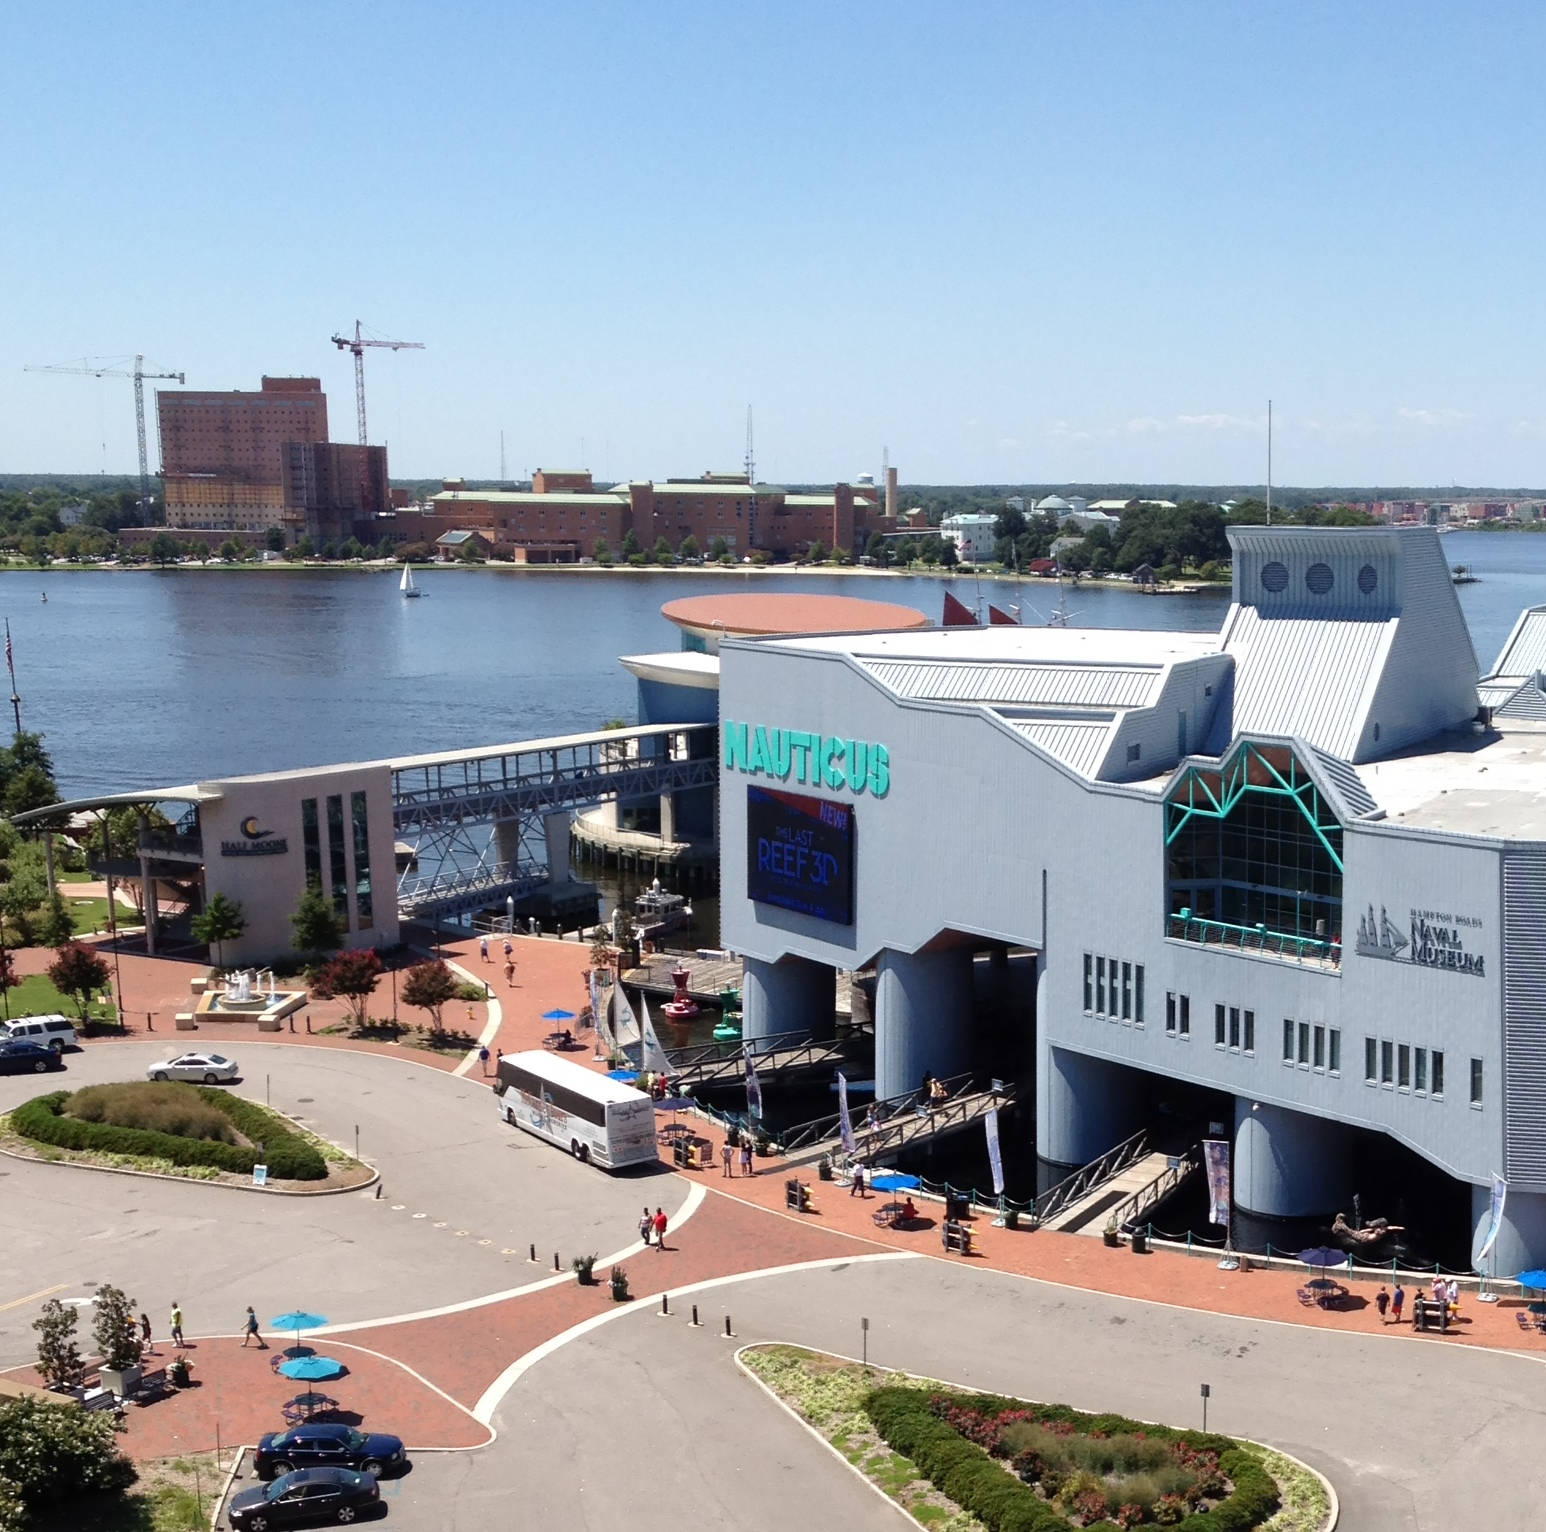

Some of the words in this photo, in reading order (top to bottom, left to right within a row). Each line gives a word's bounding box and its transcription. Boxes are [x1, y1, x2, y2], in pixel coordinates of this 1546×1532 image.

[724, 719, 890, 799] NAUTICUS
[820, 801, 848, 831] NEW!
[788, 826, 814, 847] LAST
[758, 837, 808, 878] REEF
[810, 850, 839, 886] 3D
[1410, 917, 1463, 949] NAVAL
[1410, 935, 1485, 972] MUSEUM
